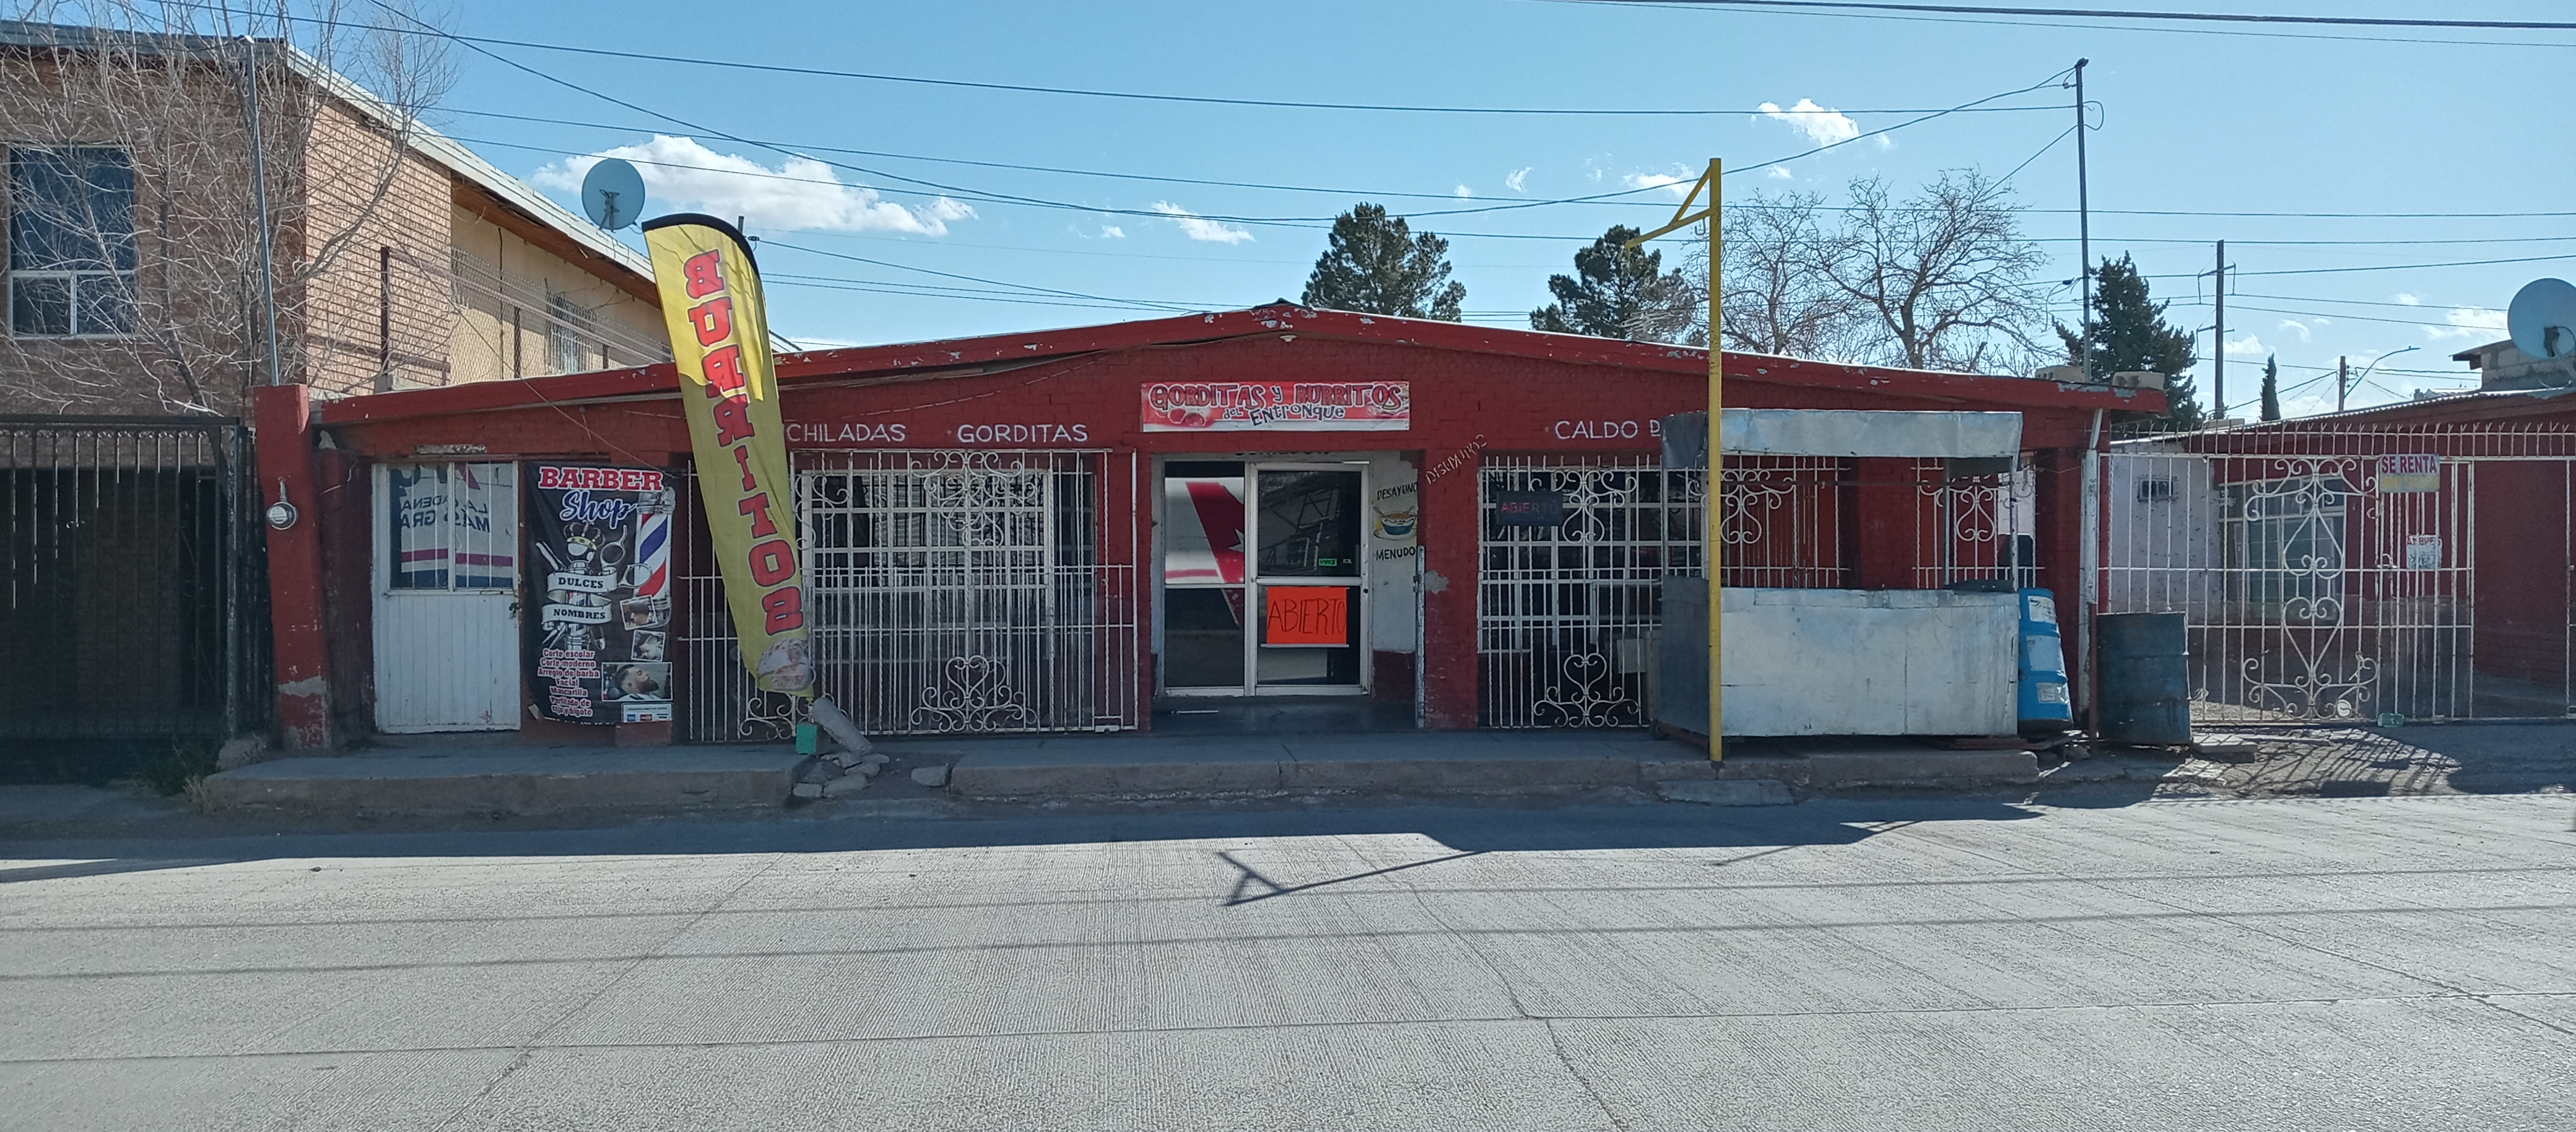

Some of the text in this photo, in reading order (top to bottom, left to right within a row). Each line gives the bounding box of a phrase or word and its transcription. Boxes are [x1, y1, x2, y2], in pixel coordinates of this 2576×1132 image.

[1150, 384, 1266, 412] GORDITAS
[1295, 384, 1403, 411] BURRITOS
[782, 423, 906, 442] CHILADAS
[957, 424, 1088, 443] GORDITAS
[1555, 420, 1638, 439] CALDO
[2382, 455, 2437, 474] SE RENTA
[538, 466, 664, 492] BARBER
[559, 490, 638, 529] Shop
[1501, 499, 1559, 514] ABIERTO
[1376, 546, 1416, 561] MENUDO
[558, 577, 604, 589] DULCES
[553, 608, 606, 619] NOMBRES
[1268, 598, 1346, 635] ABIERTO
[543, 648, 594, 658] Corte escolar
[541, 658, 596, 668] Corte moderno
[538, 668, 599, 678] Arreglo de barba
[556, 678, 579, 687] Facial
[550, 686, 588, 697] Mascarilla
[580, 699, 591, 708] de
[570, 707, 593, 717] bigote
